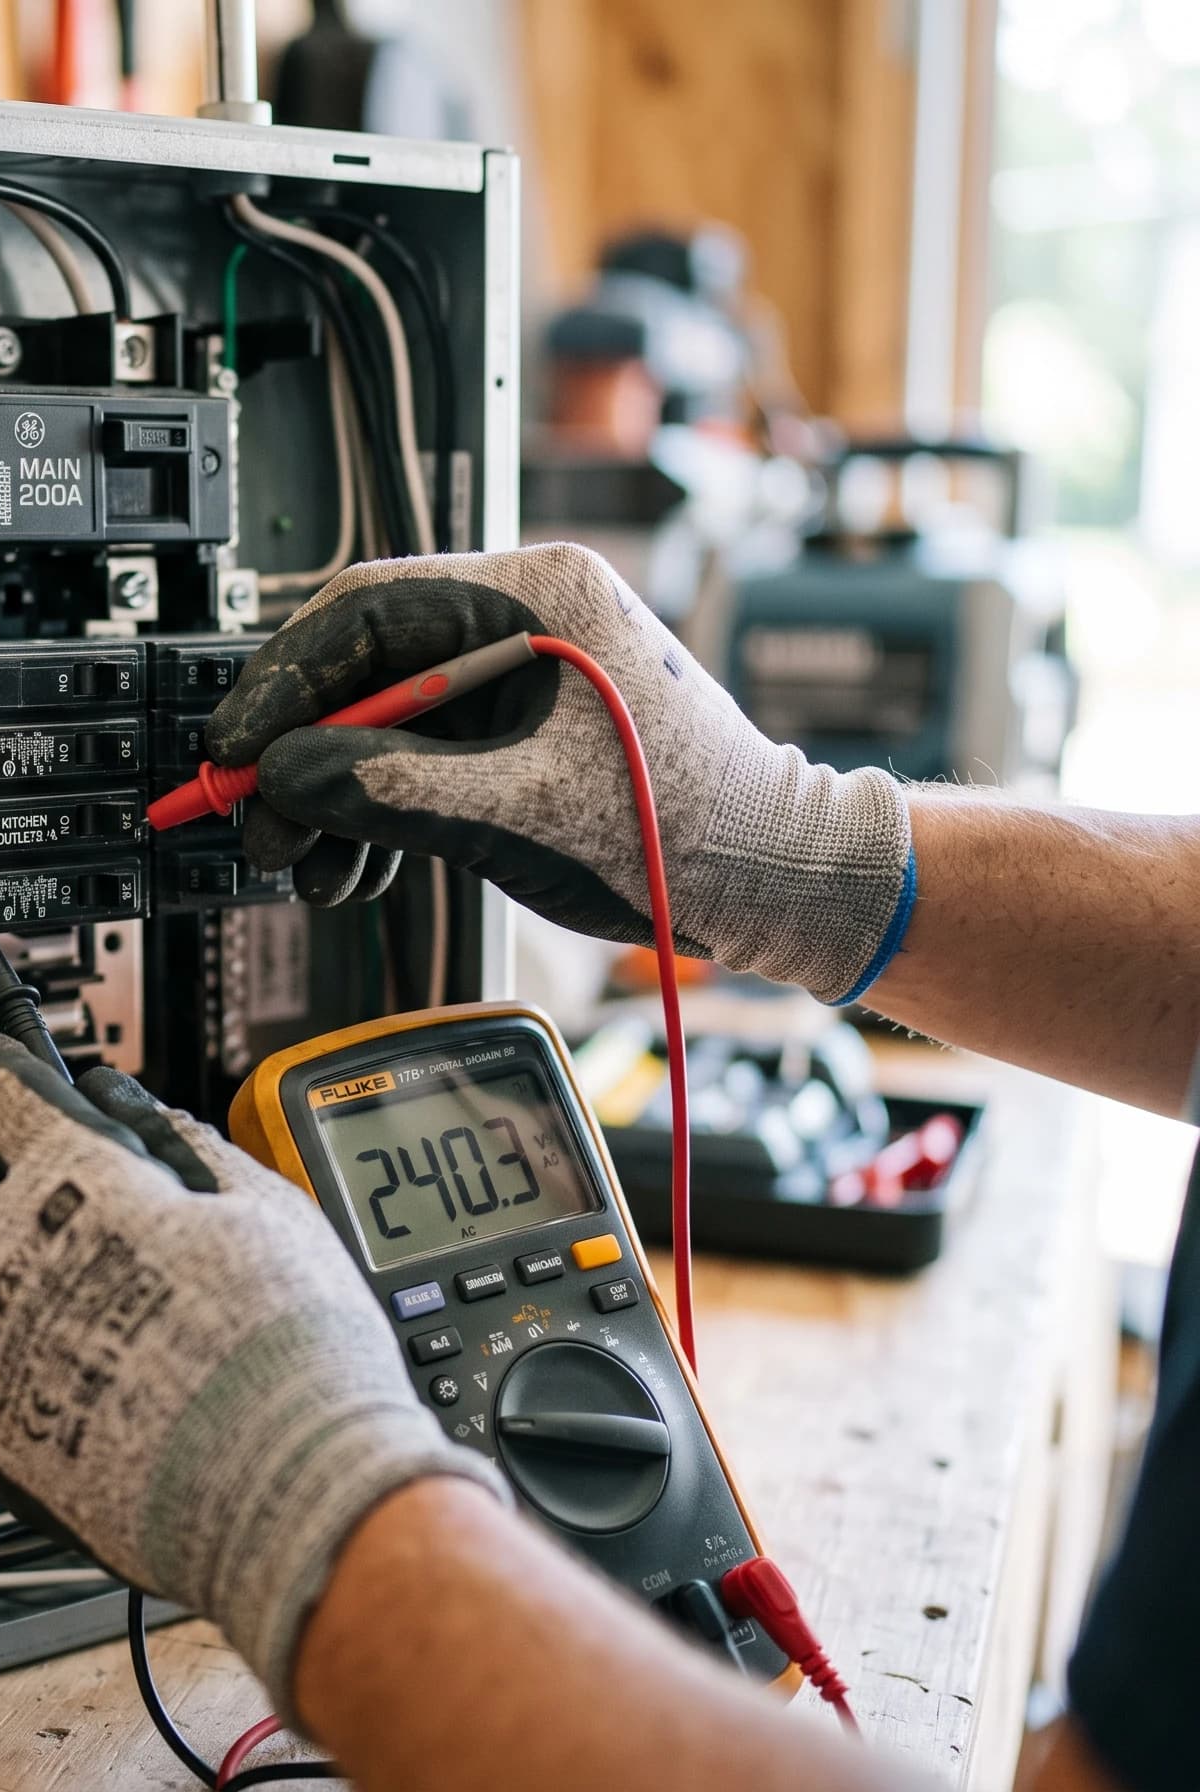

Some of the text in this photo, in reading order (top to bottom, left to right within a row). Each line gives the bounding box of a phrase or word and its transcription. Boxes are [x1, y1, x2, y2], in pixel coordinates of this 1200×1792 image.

[19, 457, 81, 480] MAIN
[19, 483, 83, 506] 200A
[58, 673, 69, 693] ON
[119, 671, 130, 690] 20
[216, 667, 228, 685] 20
[59, 743, 70, 763] ON
[121, 740, 132, 758] 20
[1, 814, 48, 829] KITCHEN
[60, 815, 71, 835] ON
[61, 885, 72, 905] ON
[319, 1076, 389, 1103] FLUKE
[356, 1115, 541, 1240] 240.3
[461, 1225, 477, 1239] AC
